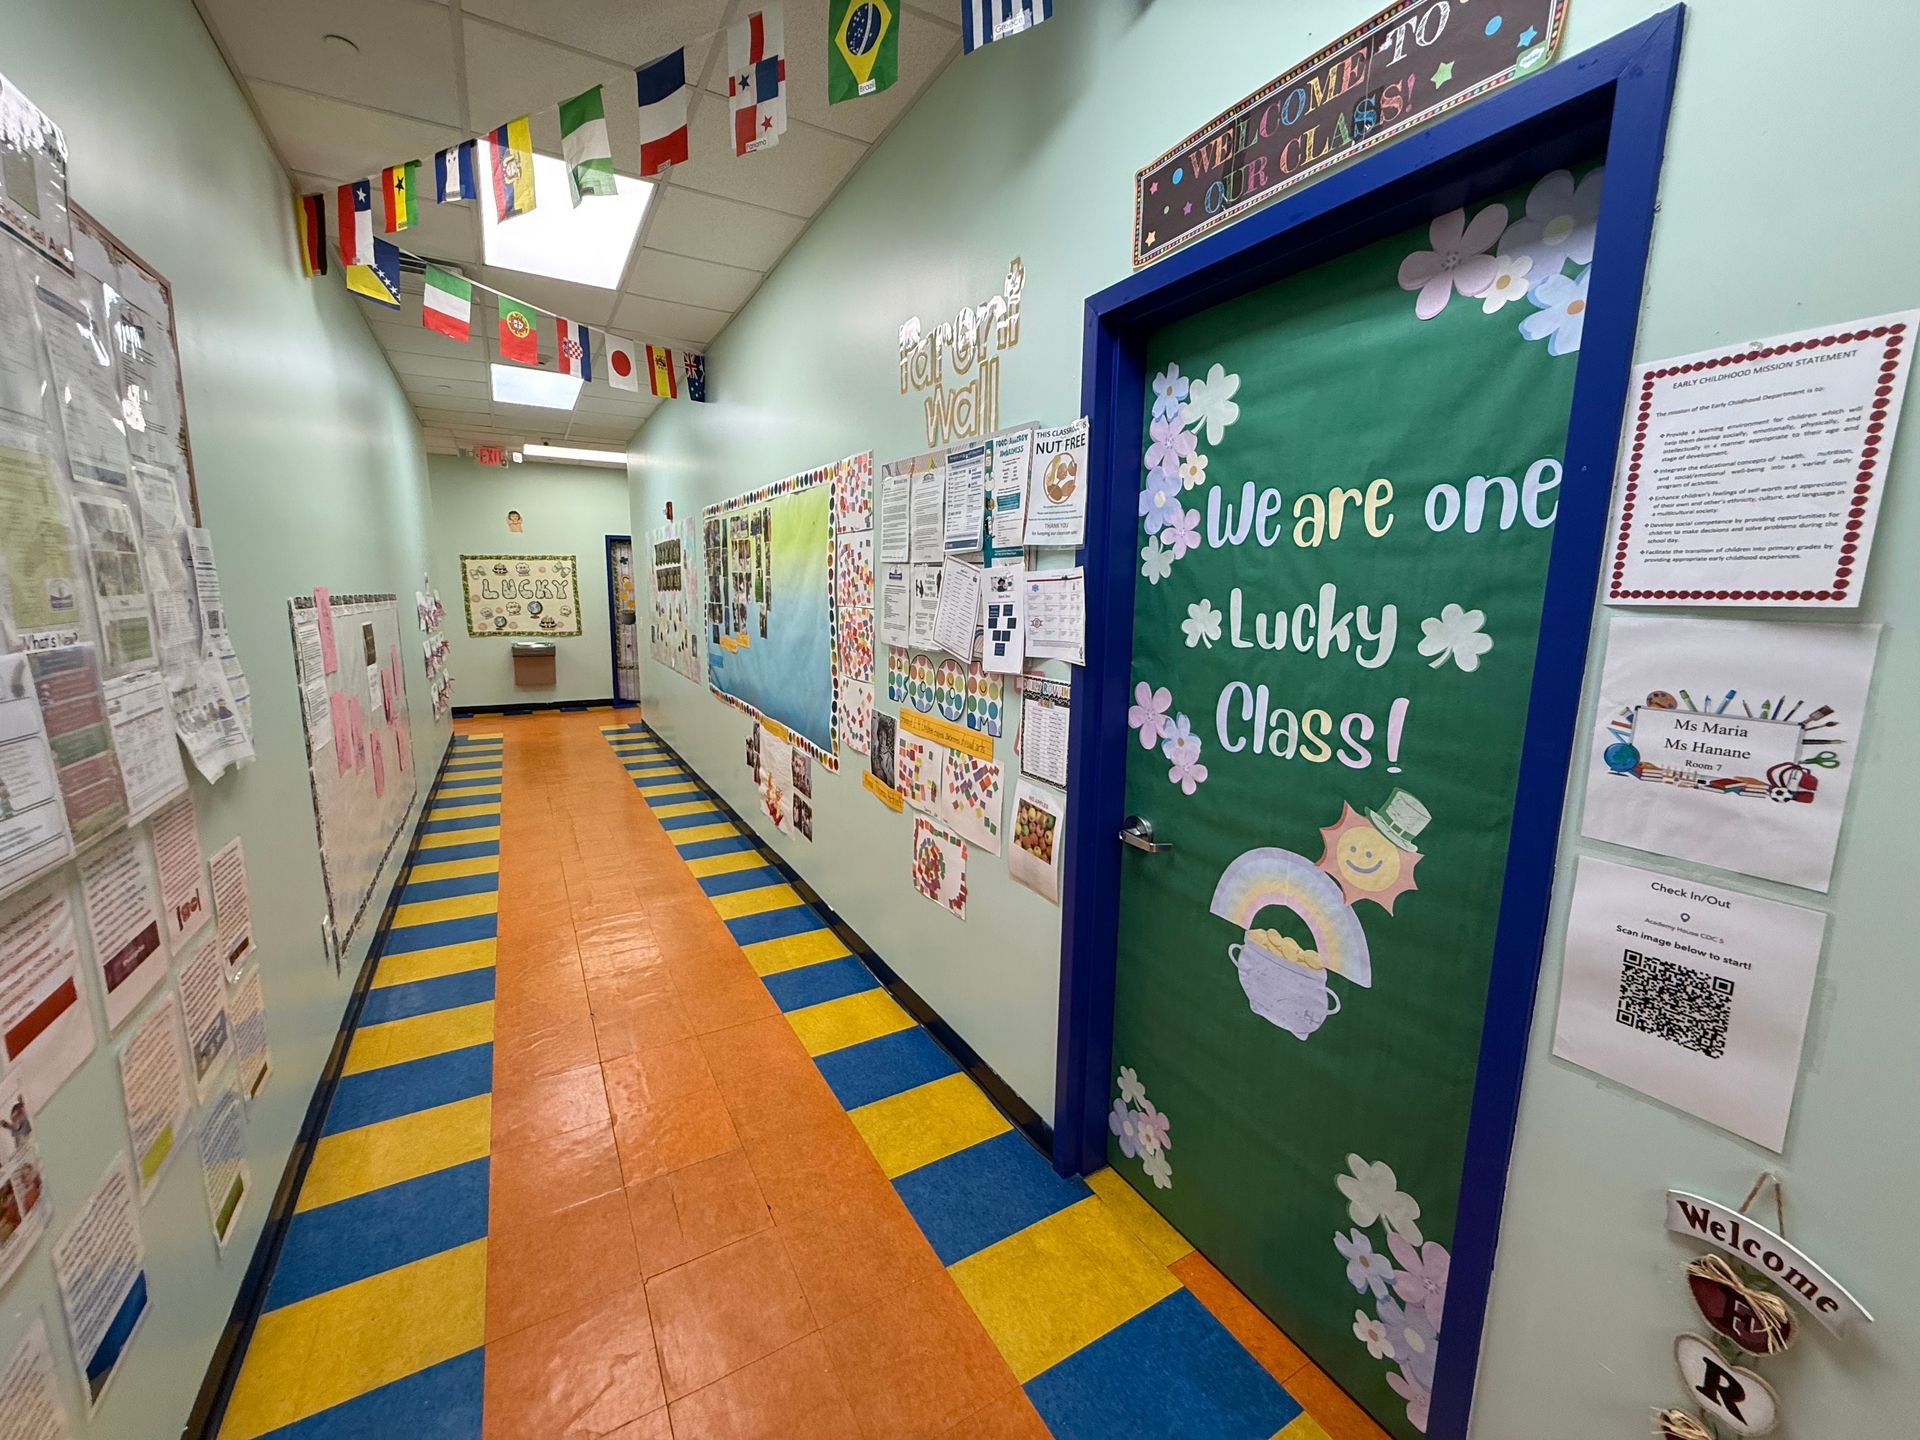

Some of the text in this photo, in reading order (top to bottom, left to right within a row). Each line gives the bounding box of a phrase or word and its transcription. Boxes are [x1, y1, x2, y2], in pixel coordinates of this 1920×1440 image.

[859, 82, 875, 93] Brazil
[1189, 1, 1450, 180] WELCOME TO
[747, 140, 767, 150] Panama
[1205, 73, 1416, 215] OUR CLASS!
[1672, 349, 1858, 389] EARLY CHILDHOOD MISSION STATEMENT
[479, 447, 503, 464] EXIT
[1036, 433, 1086, 455] NUT FREE
[1207, 456, 1564, 548] We are one
[481, 578, 569, 600] LUCKY
[1229, 582, 1398, 668] Lucky
[1216, 681, 1410, 774] Class!
[1674, 719, 1749, 738] Ms Maria
[1664, 737, 1752, 760] Ms Hanane
[1685, 759, 1713, 771] Room
[1651, 882, 1731, 909] Check In/Out
[1644, 917, 1675, 931] Academy
[1676, 926, 1699, 937] House
[1700, 933, 1719, 942] CDC
[1616, 924, 1752, 970] Scan image below to start!
[1676, 1200, 1839, 1314] Welcome
[1695, 1356, 1748, 1427] R
